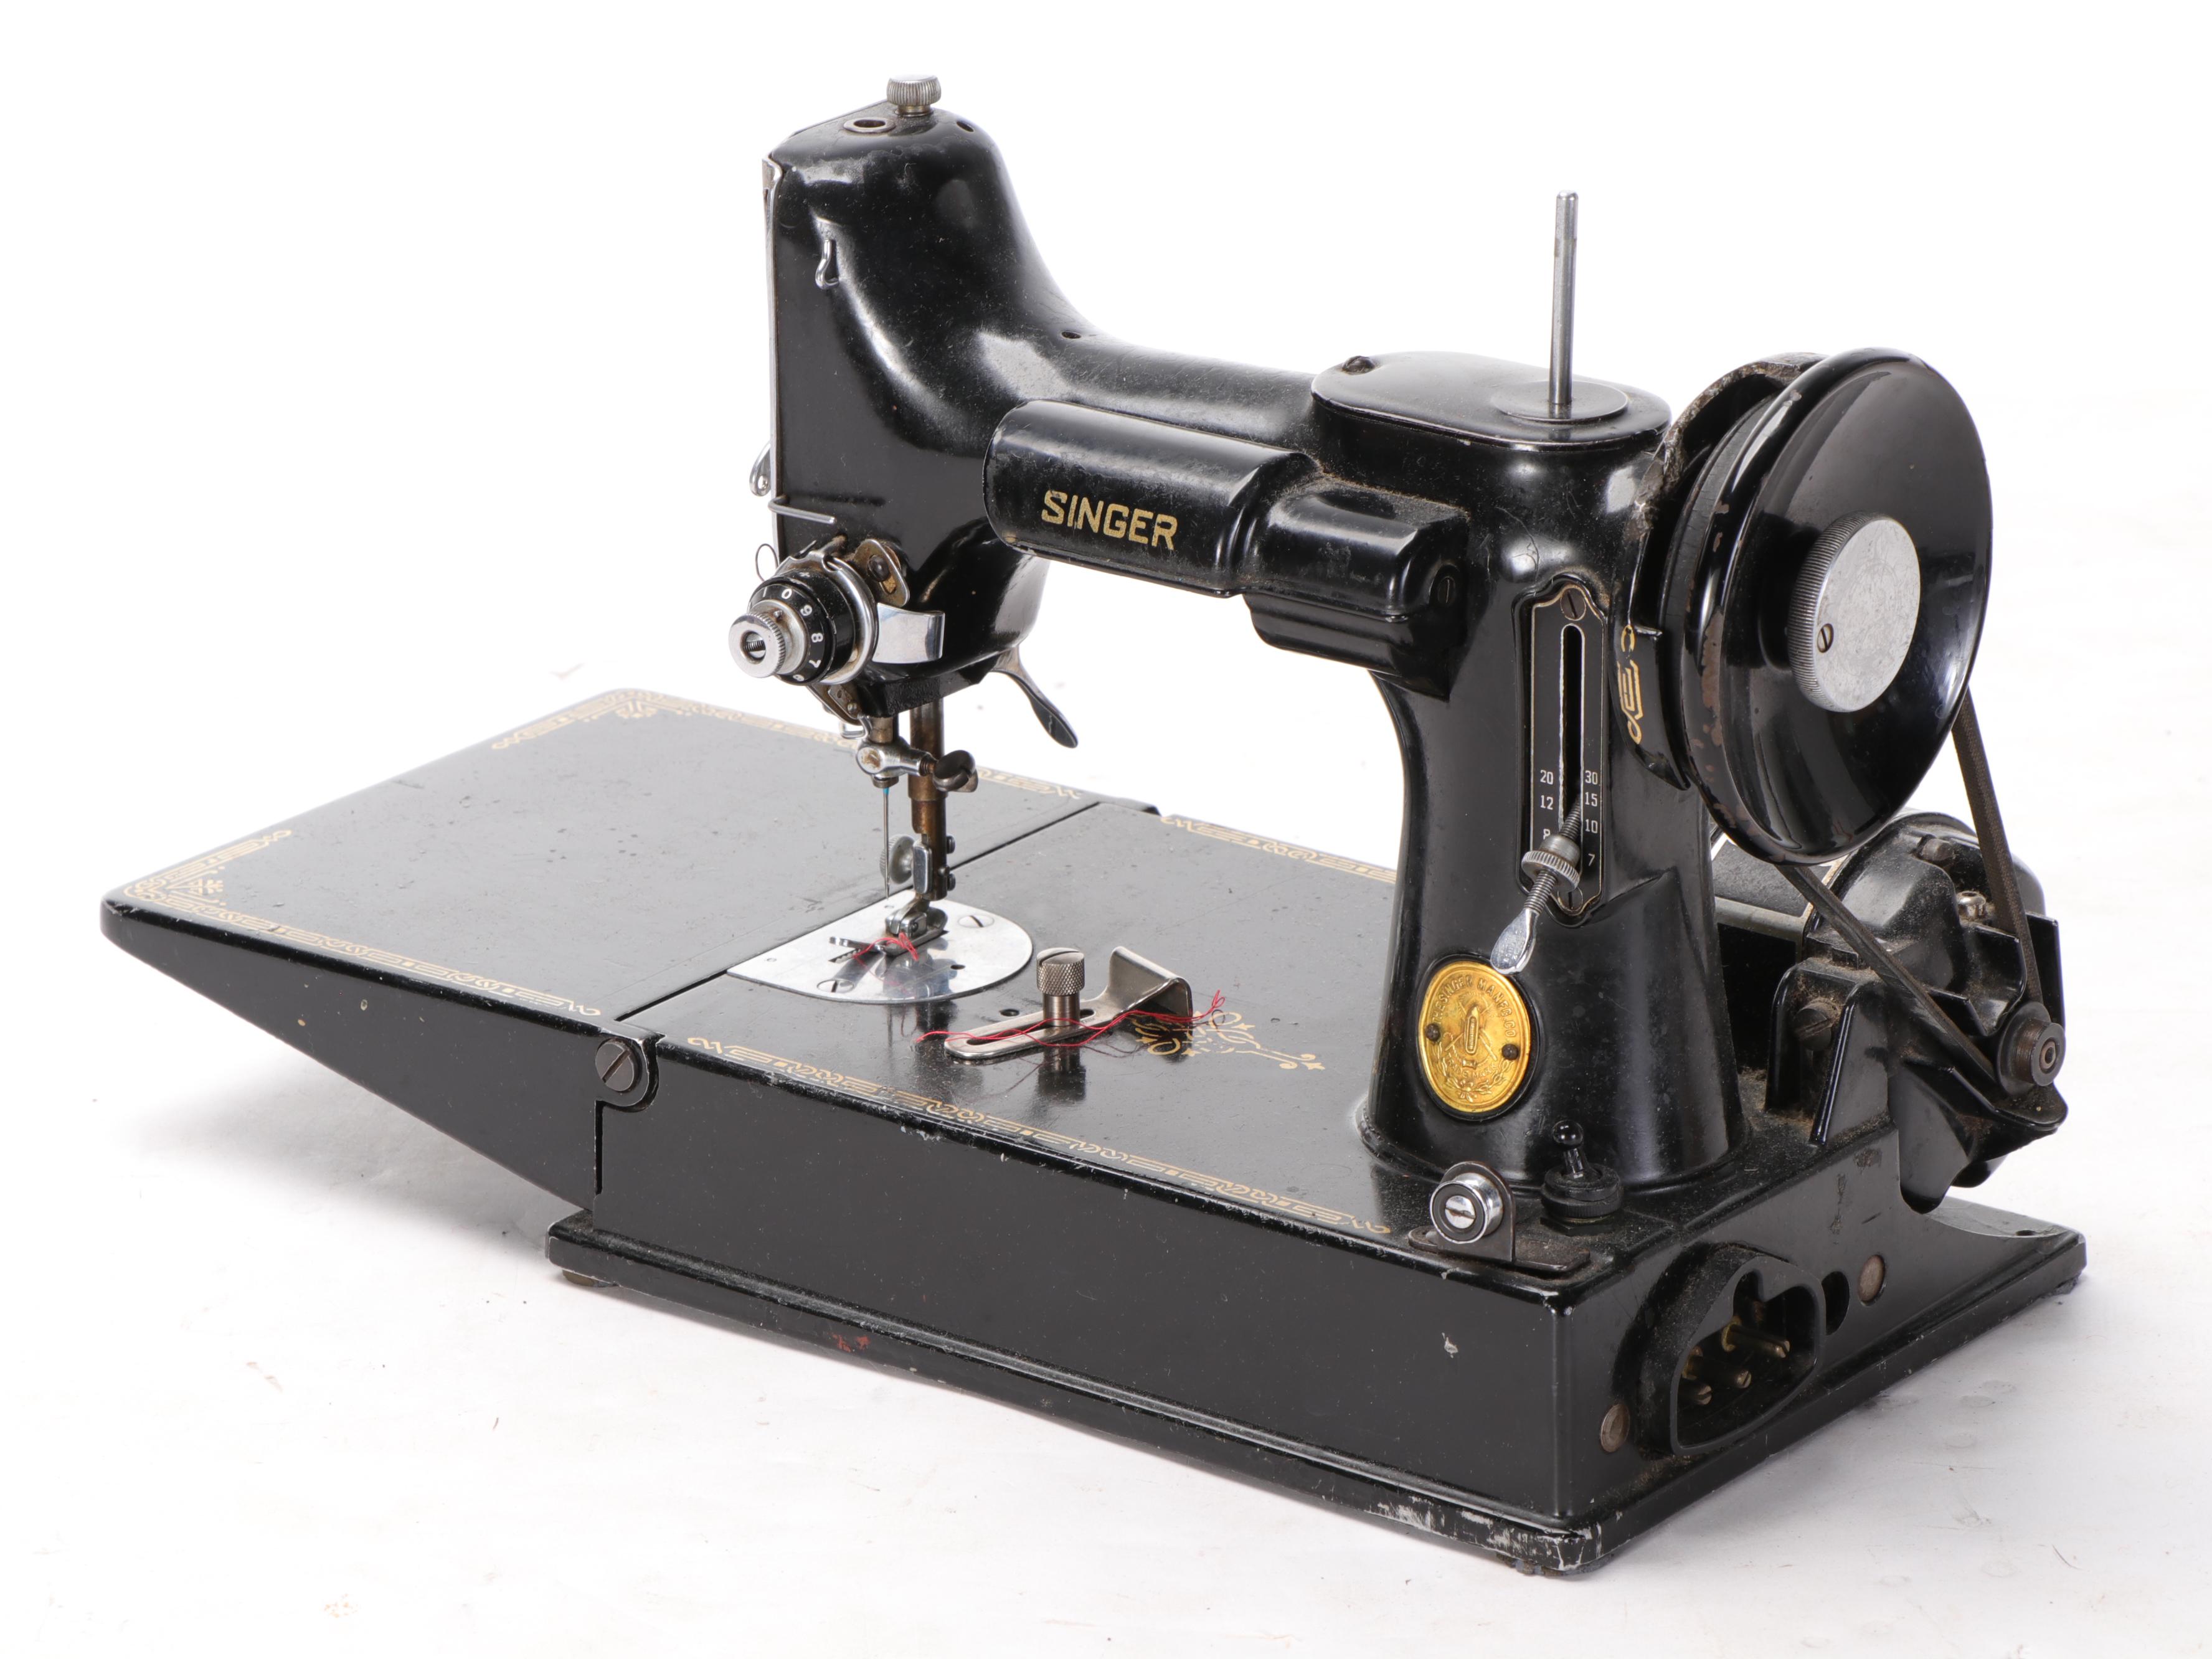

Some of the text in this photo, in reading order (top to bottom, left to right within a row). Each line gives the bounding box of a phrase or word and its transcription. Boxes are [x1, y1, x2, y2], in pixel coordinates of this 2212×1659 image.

[1041, 489, 1178, 551] SINGER
[782, 588, 792, 599] 0
[811, 633, 823, 643] 8
[809, 659, 821, 668] 7
[1539, 769, 1554, 785] 20
[1584, 770, 1599, 785] 30
[1540, 795, 1554, 810] 12
[1585, 792, 1598, 807] 15
[1585, 819, 1599, 834] 10
[1587, 853, 1595, 867] 7
[1432, 1000, 1445, 1024] THE
[1439, 975, 1473, 1004] SINGER
